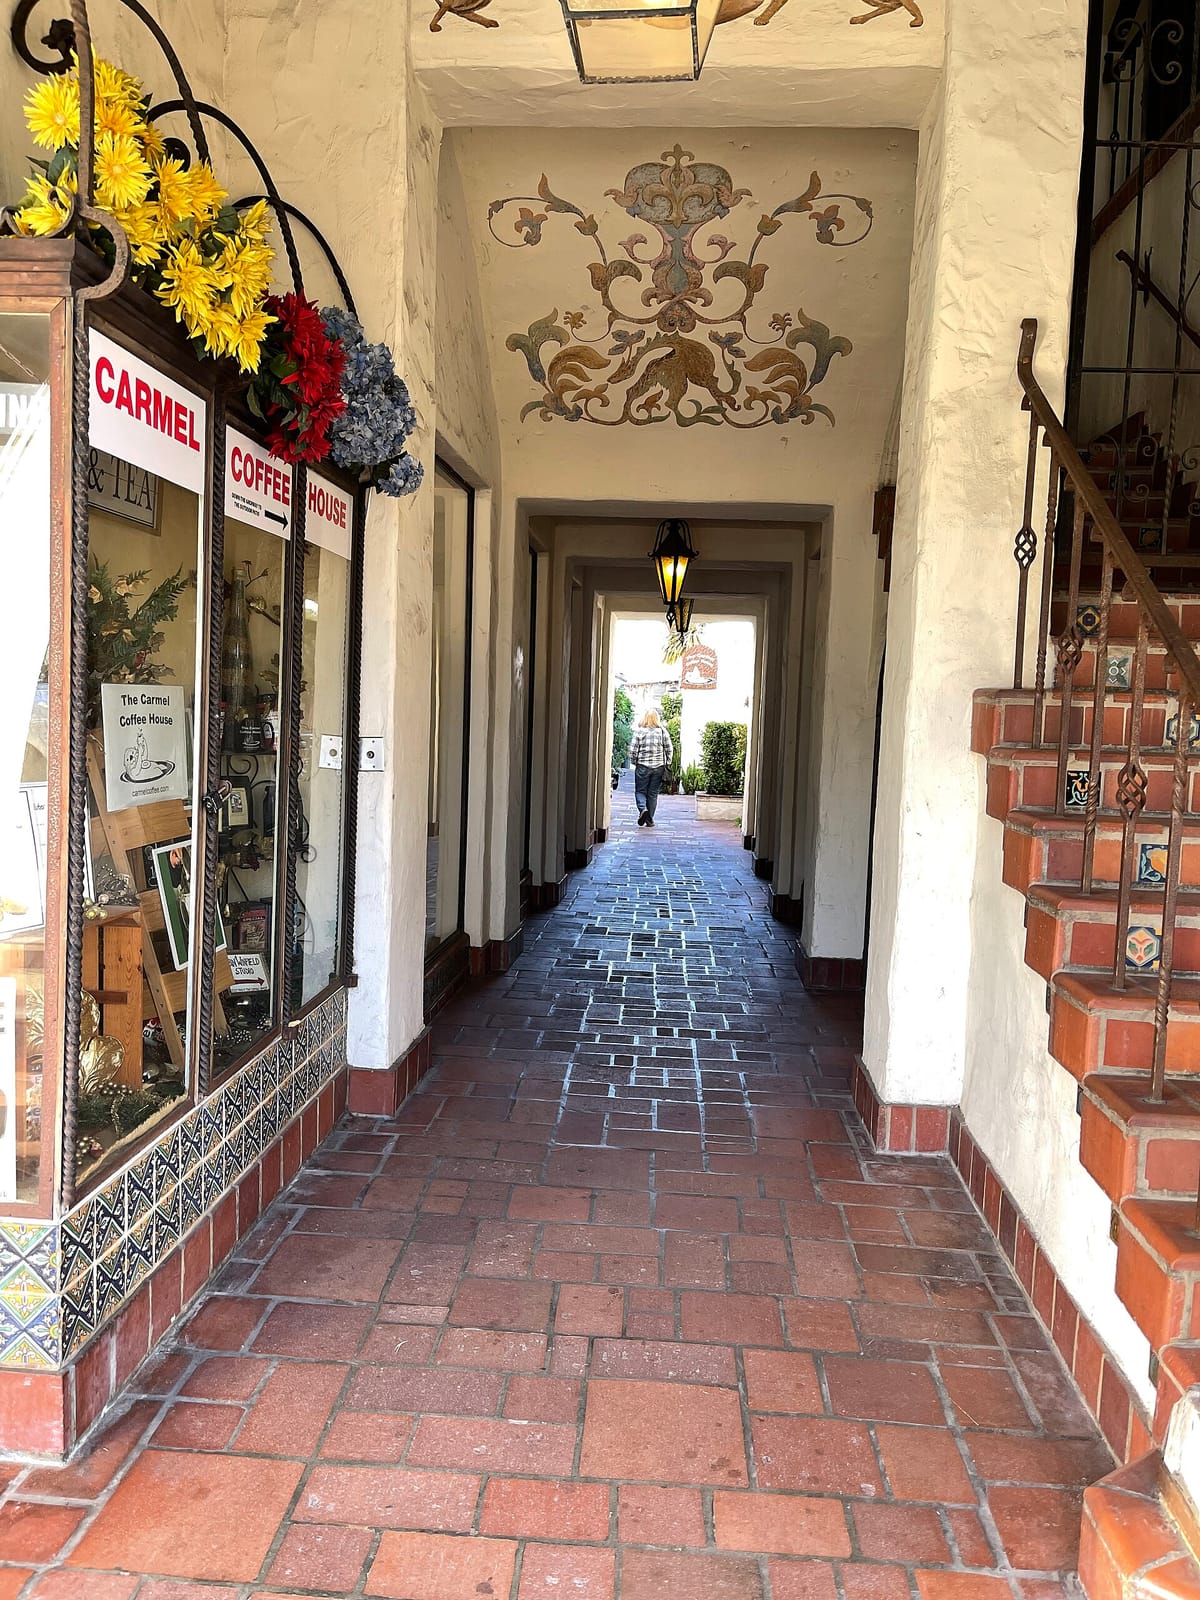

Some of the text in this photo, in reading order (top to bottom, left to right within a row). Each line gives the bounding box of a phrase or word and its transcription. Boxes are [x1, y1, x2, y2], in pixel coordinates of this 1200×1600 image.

[95, 356, 200, 452] CARMEL
[88, 448, 152, 511] & TEA
[231, 446, 291, 506] COFFEE
[308, 482, 346, 529] HOUSE
[121, 693, 170, 706] The Carmel
[120, 713, 173, 727] Coffee House
[132, 786, 169, 797] carmelcoffee.com
[235, 967, 254, 975] STUDIO
